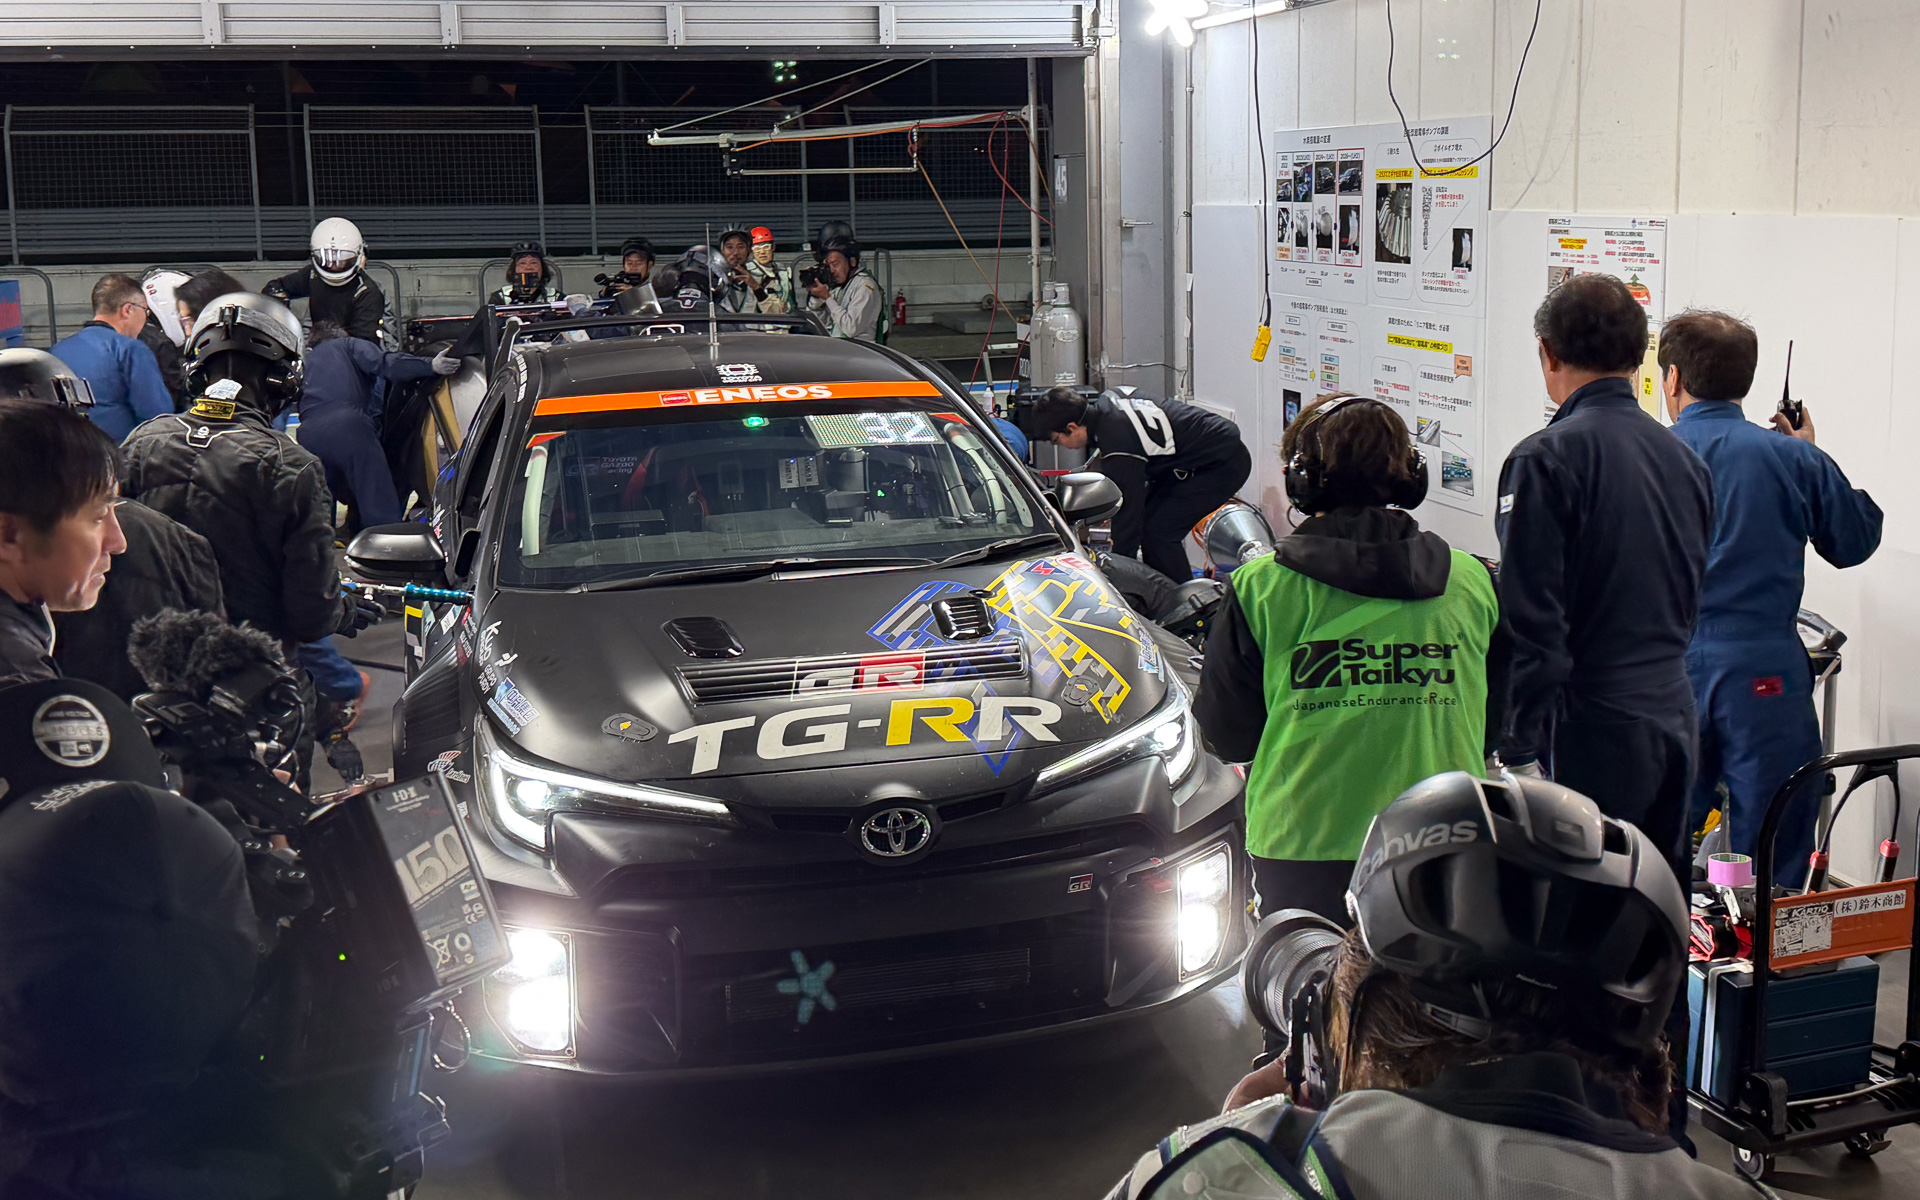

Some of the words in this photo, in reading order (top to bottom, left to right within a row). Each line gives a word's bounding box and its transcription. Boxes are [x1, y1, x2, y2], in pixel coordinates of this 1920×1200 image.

[694, 385, 833, 404] ENEOS
[856, 411, 938, 443] 32
[1342, 638, 1459, 665] Super
[799, 664, 921, 693] GR
[1342, 661, 1456, 687] Taikyu
[667, 696, 1063, 775] TG-RR
[394, 825, 470, 905] 150
[1069, 880, 1091, 891] GR
[1835, 893, 1905, 915] (株)鈴木商館
